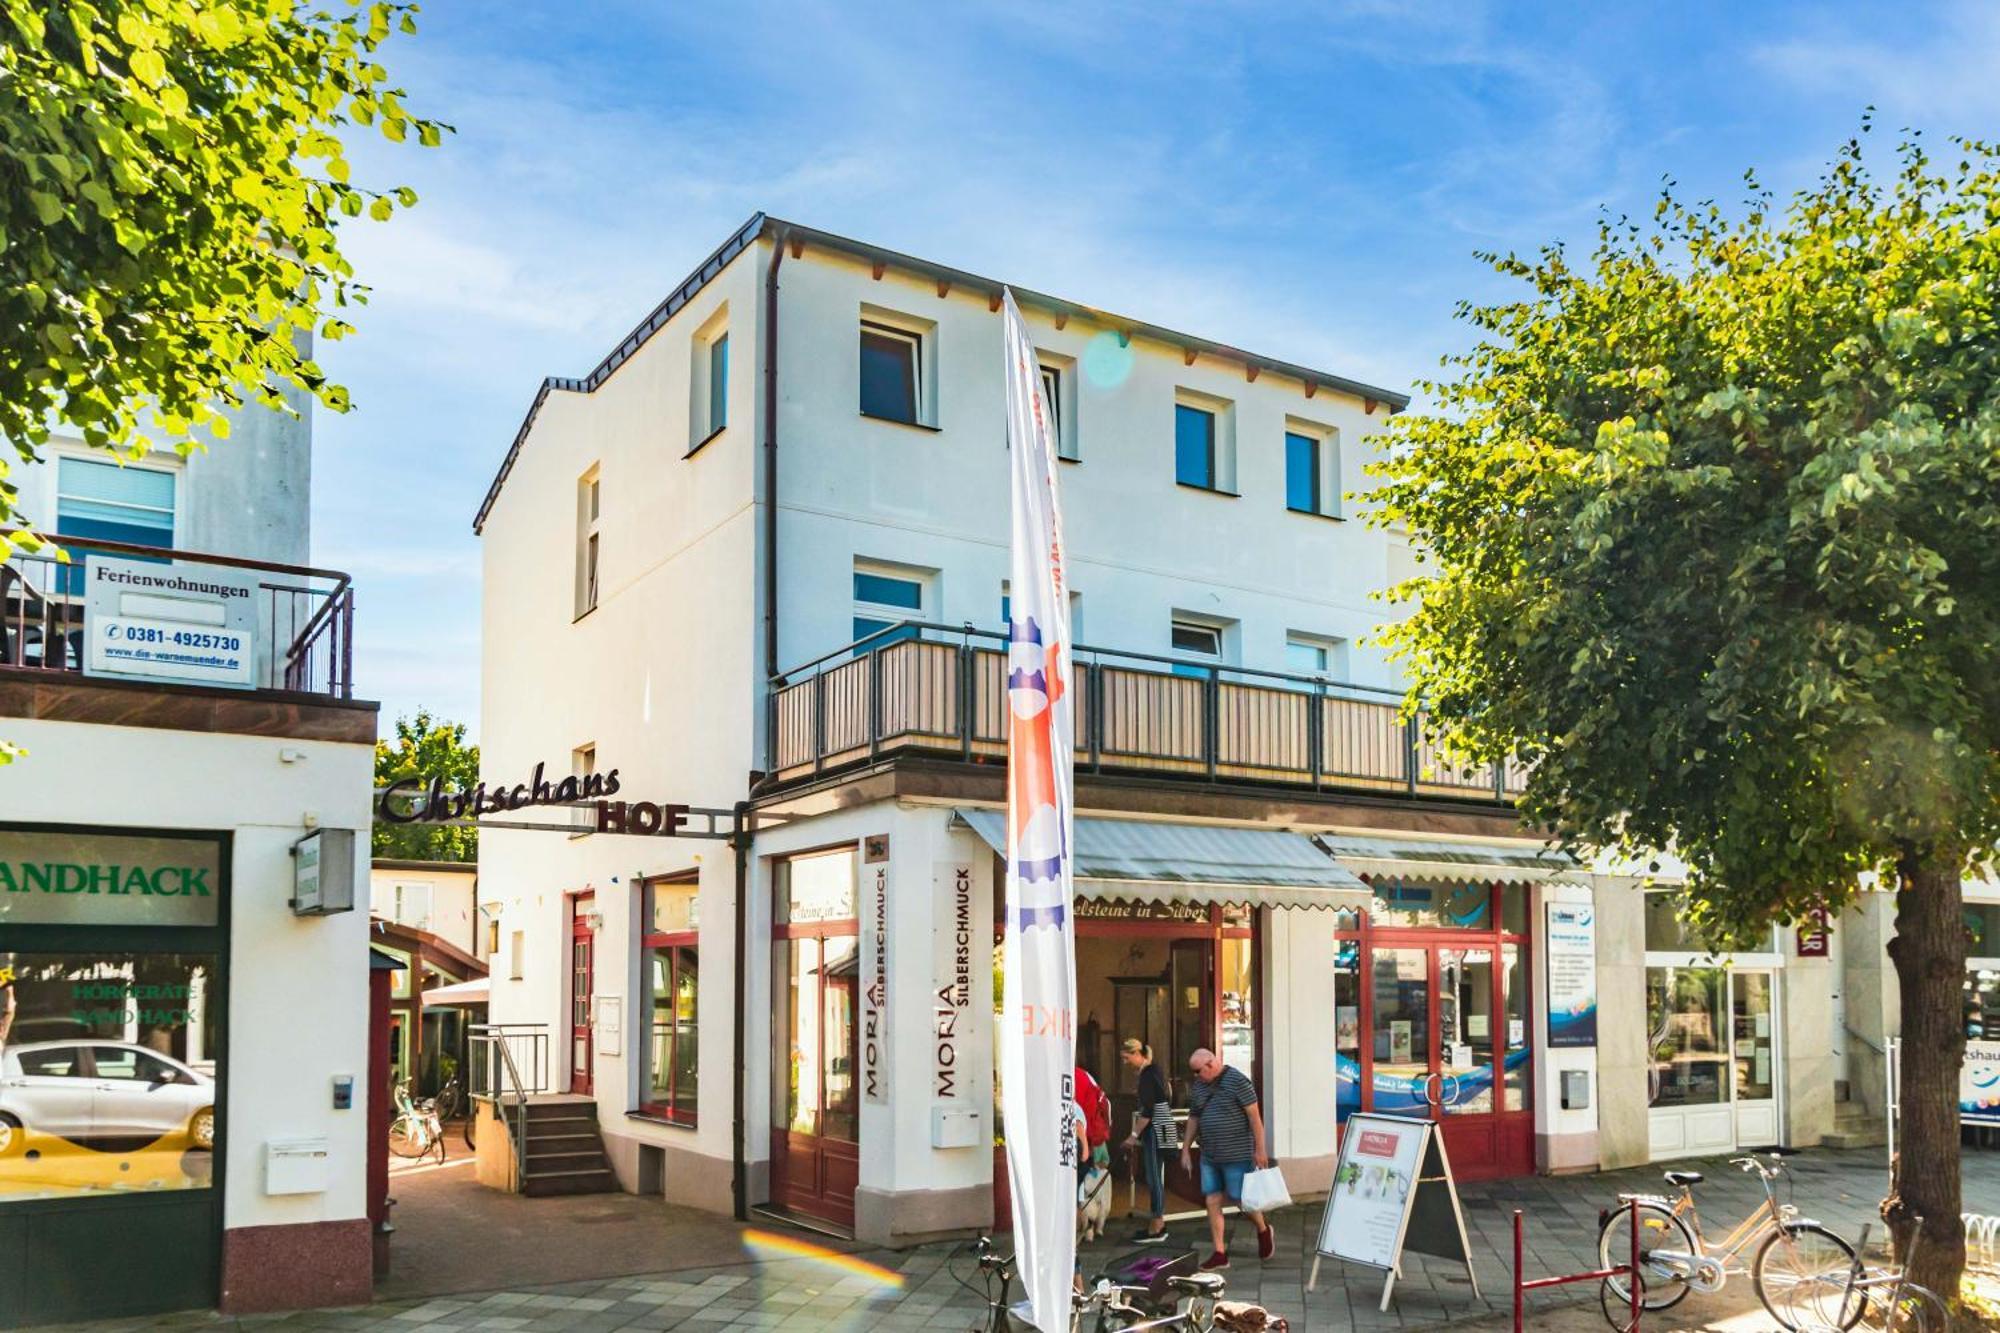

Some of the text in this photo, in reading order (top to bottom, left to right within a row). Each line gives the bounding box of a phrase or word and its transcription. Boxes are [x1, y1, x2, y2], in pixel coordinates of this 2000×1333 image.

[96, 566, 249, 599] Ferienwohnungen
[127, 627, 240, 651] 0381-4925730
[380, 761, 621, 824] Chrischans
[597, 800, 689, 836] HOF
[876, 868, 886, 1007] SILBERSCHMUCK
[956, 869, 969, 1007] SILBERSCHMUCK
[1137, 902, 1150, 917] in
[866, 984, 878, 1097] MORIA
[938, 984, 957, 1097] MORIA
